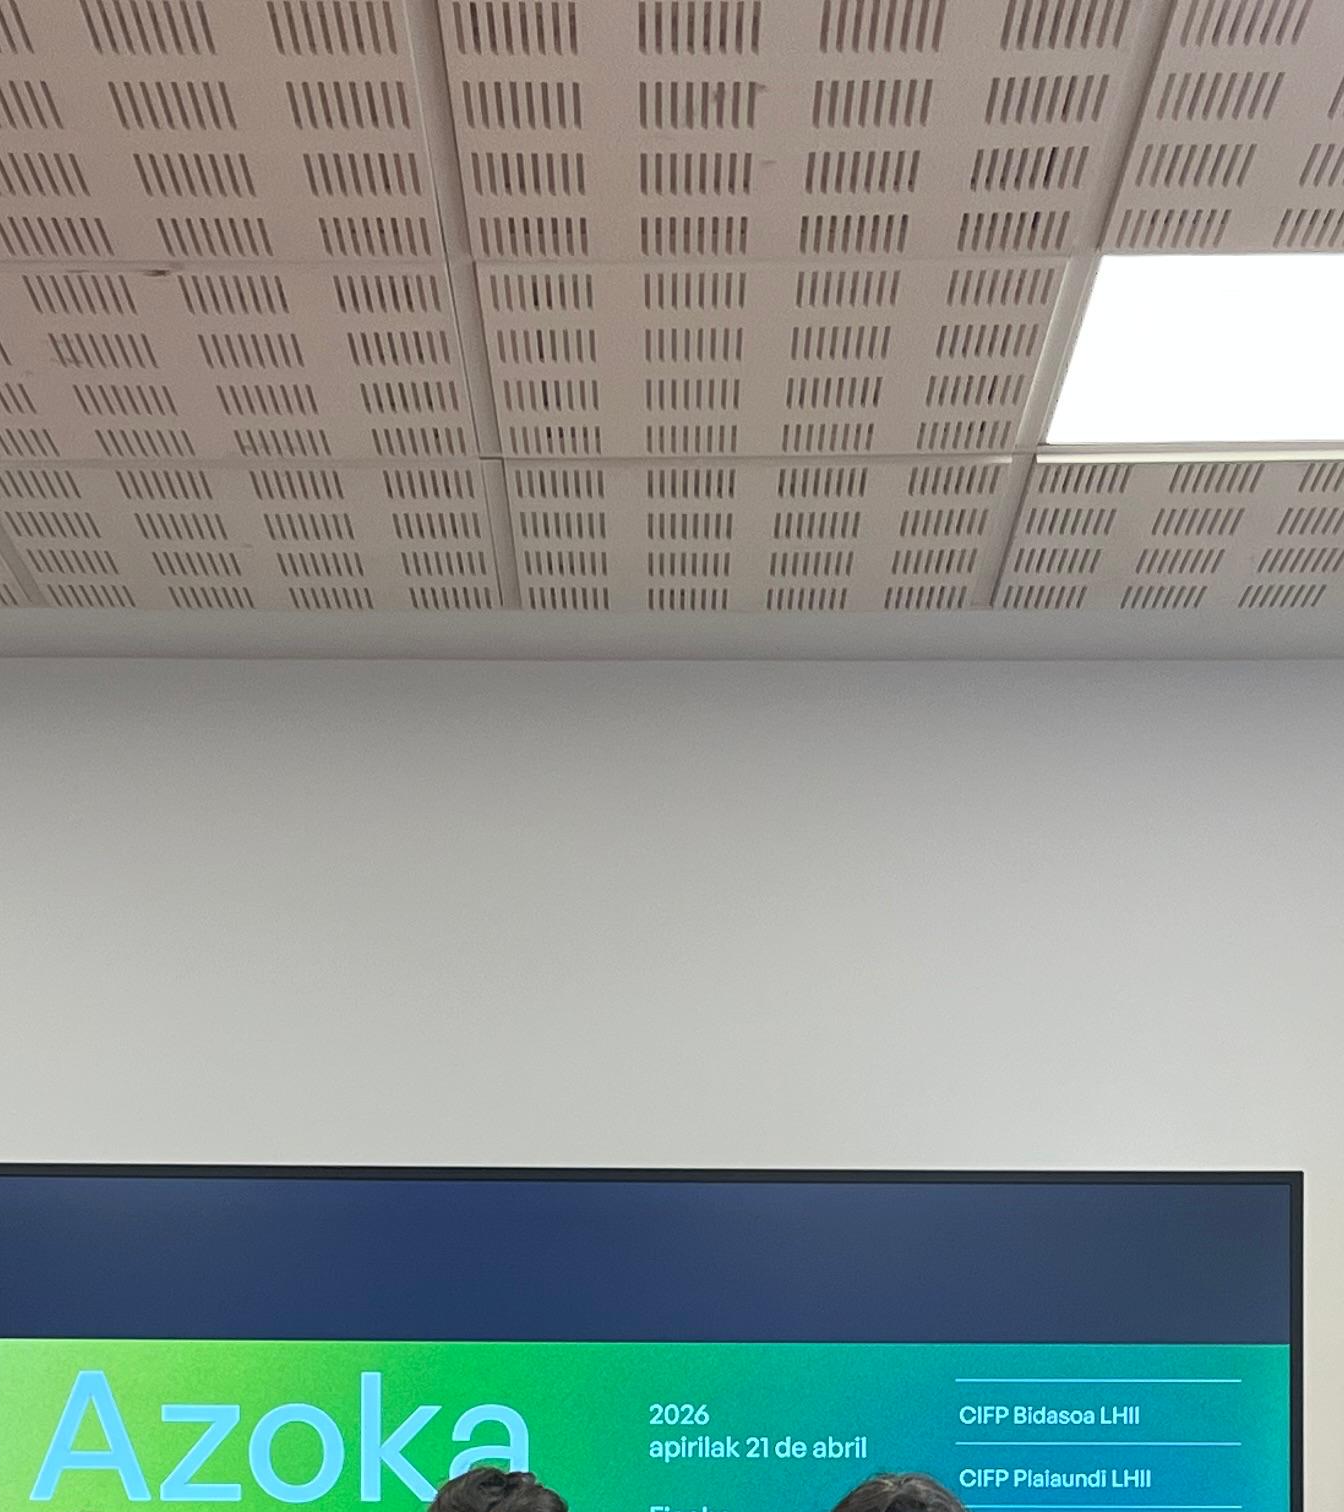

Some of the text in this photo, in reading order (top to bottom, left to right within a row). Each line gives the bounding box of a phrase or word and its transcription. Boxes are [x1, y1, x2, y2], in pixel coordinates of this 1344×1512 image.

[649, 1403, 710, 1425] 2026
[959, 1405, 1140, 1425] CIFP Bidasoa LHII
[29, 1369, 530, 1503] Azoka
[649, 1436, 867, 1463] apirilak 21 de abril
[959, 1468, 1152, 1488] CIFP Plaiaundi LHII
